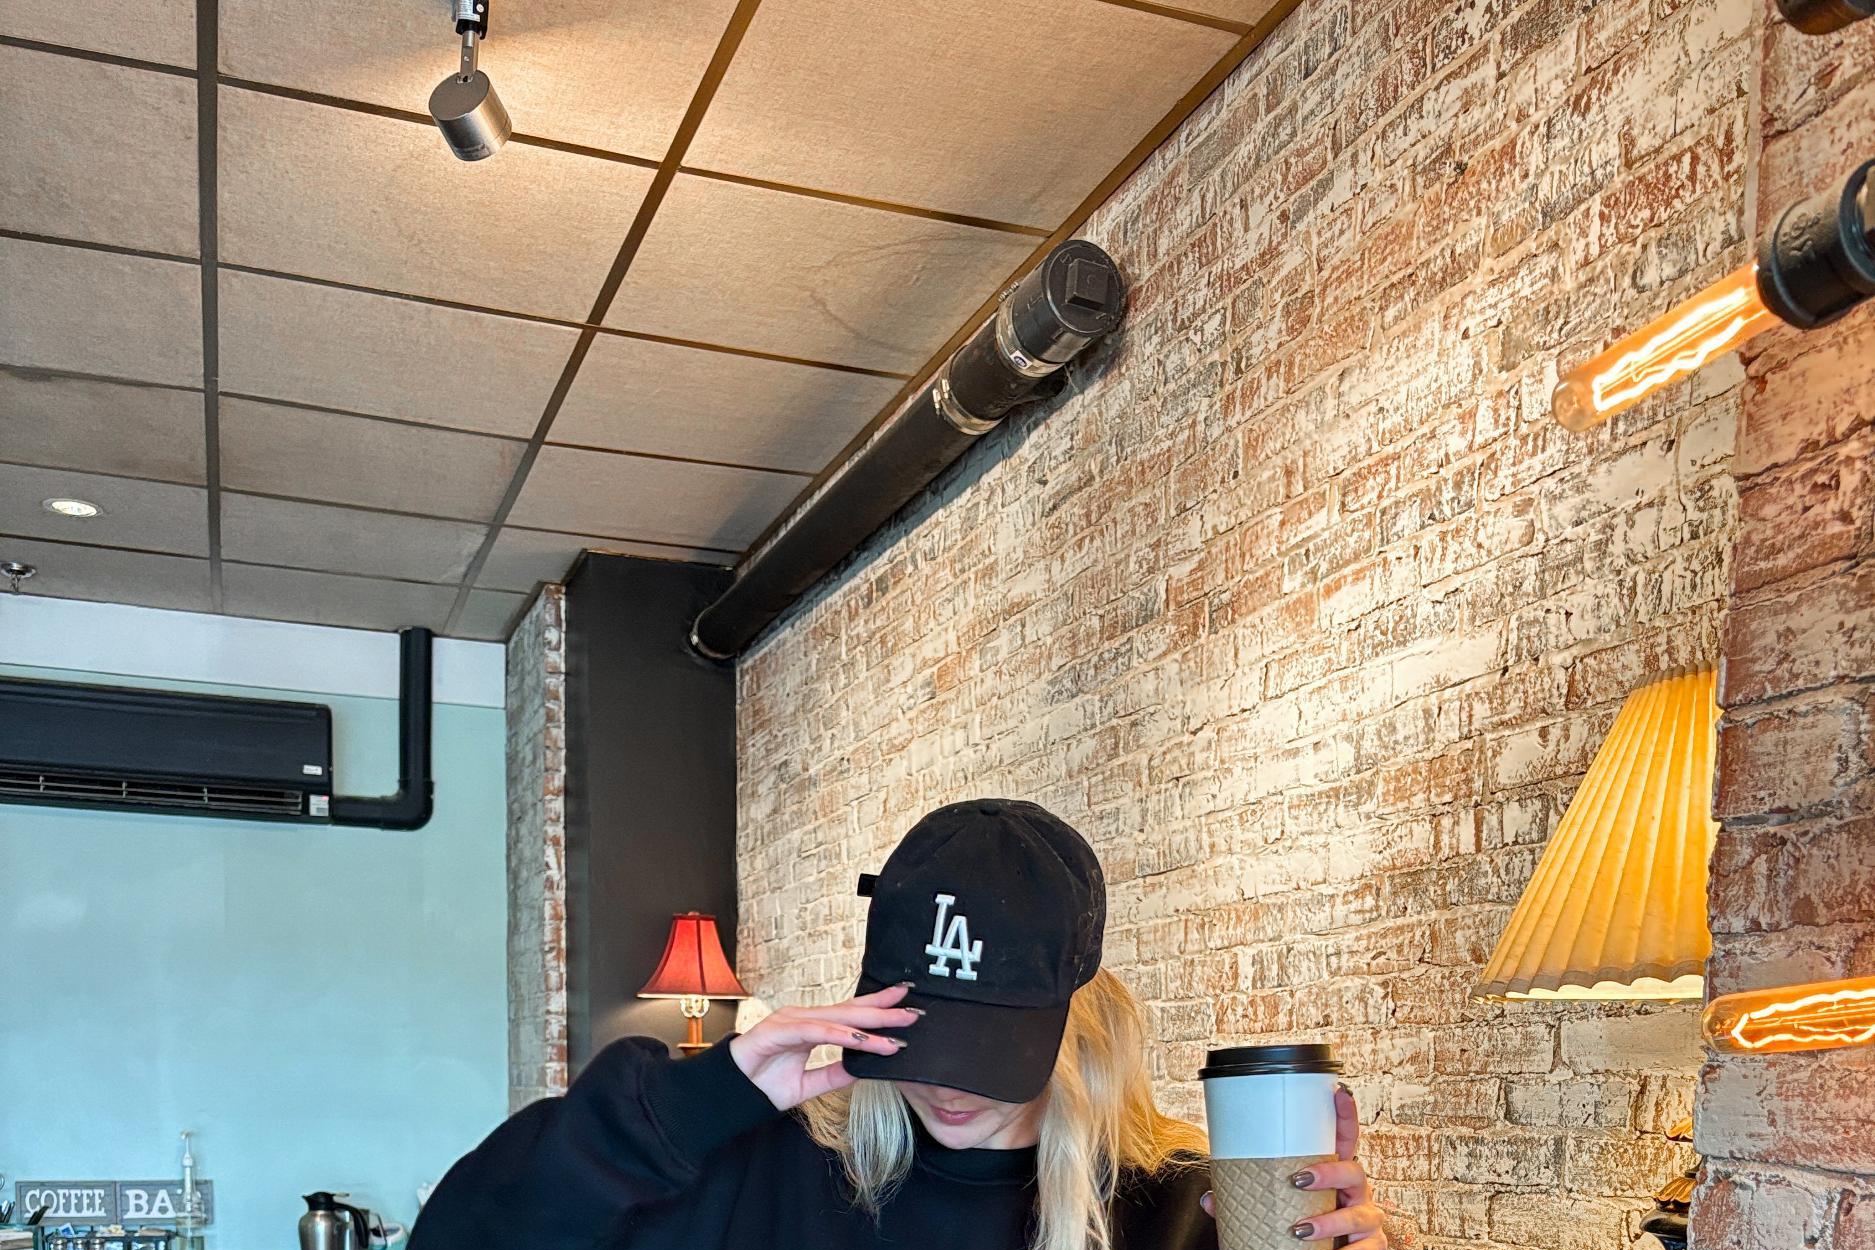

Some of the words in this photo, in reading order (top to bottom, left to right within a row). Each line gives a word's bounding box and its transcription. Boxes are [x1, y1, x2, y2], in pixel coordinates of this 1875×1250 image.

[925, 894, 983, 981] LA
[24, 1189, 107, 1218] COFFEE
[123, 1189, 200, 1219] BA
